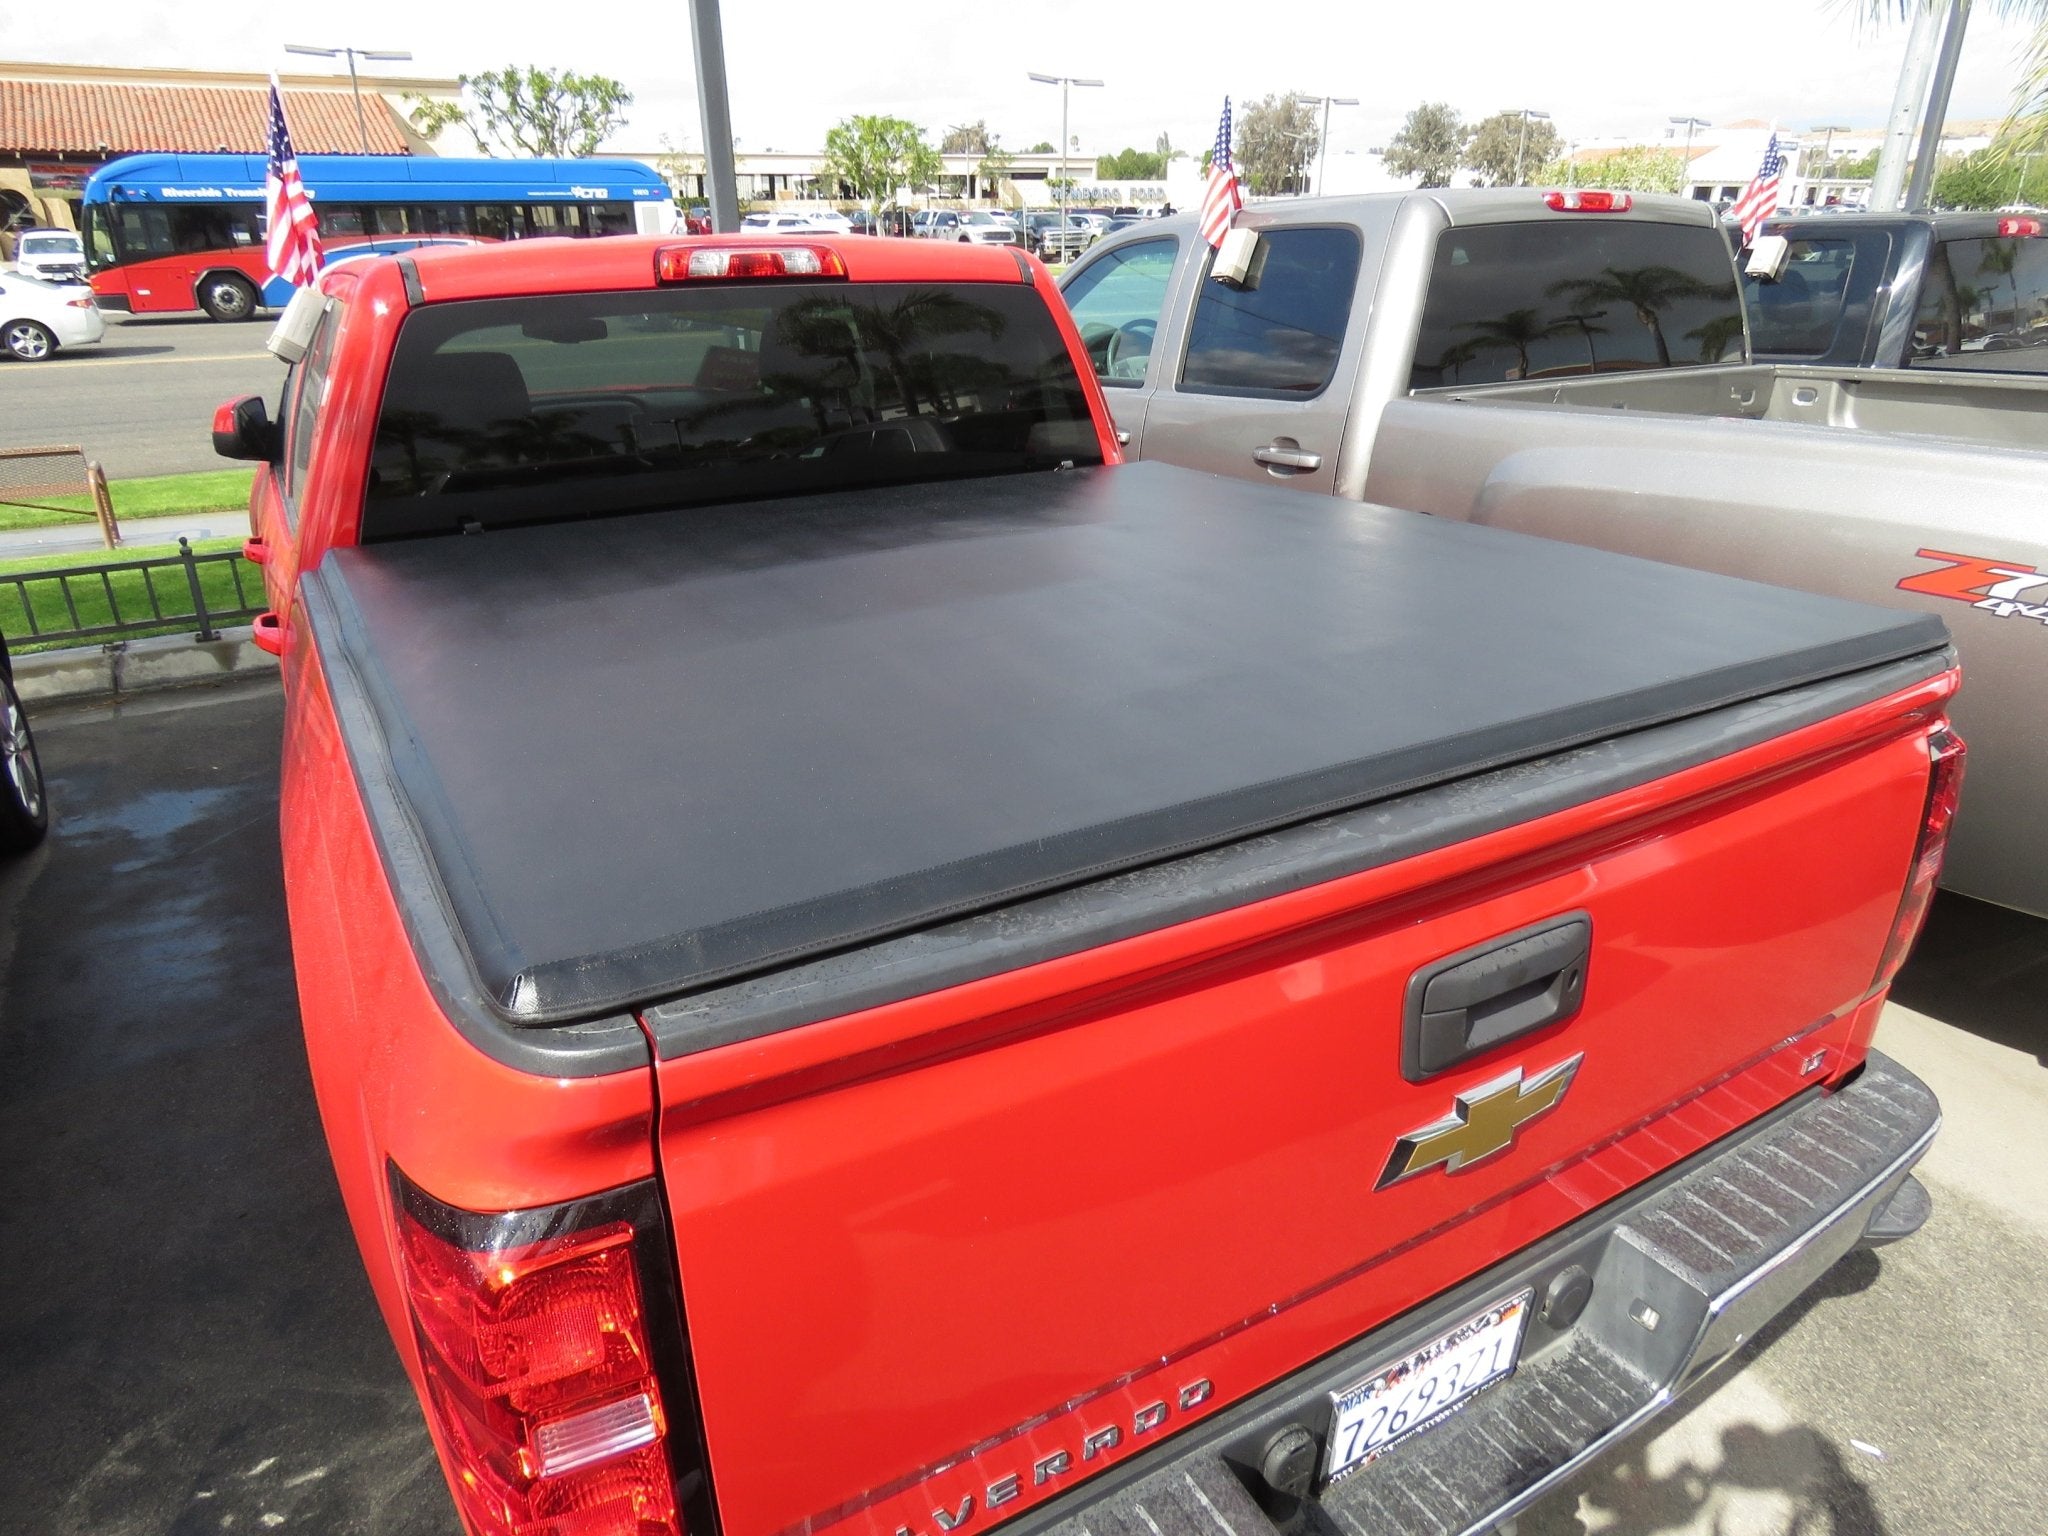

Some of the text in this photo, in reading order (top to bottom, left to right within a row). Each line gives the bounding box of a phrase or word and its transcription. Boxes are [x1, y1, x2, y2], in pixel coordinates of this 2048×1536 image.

[1129, 187, 1167, 202] FORD
[1895, 547, 2048, 604] Z7
[1800, 1048, 1827, 1077] LT
[895, 1370, 1212, 1536] VERADO
